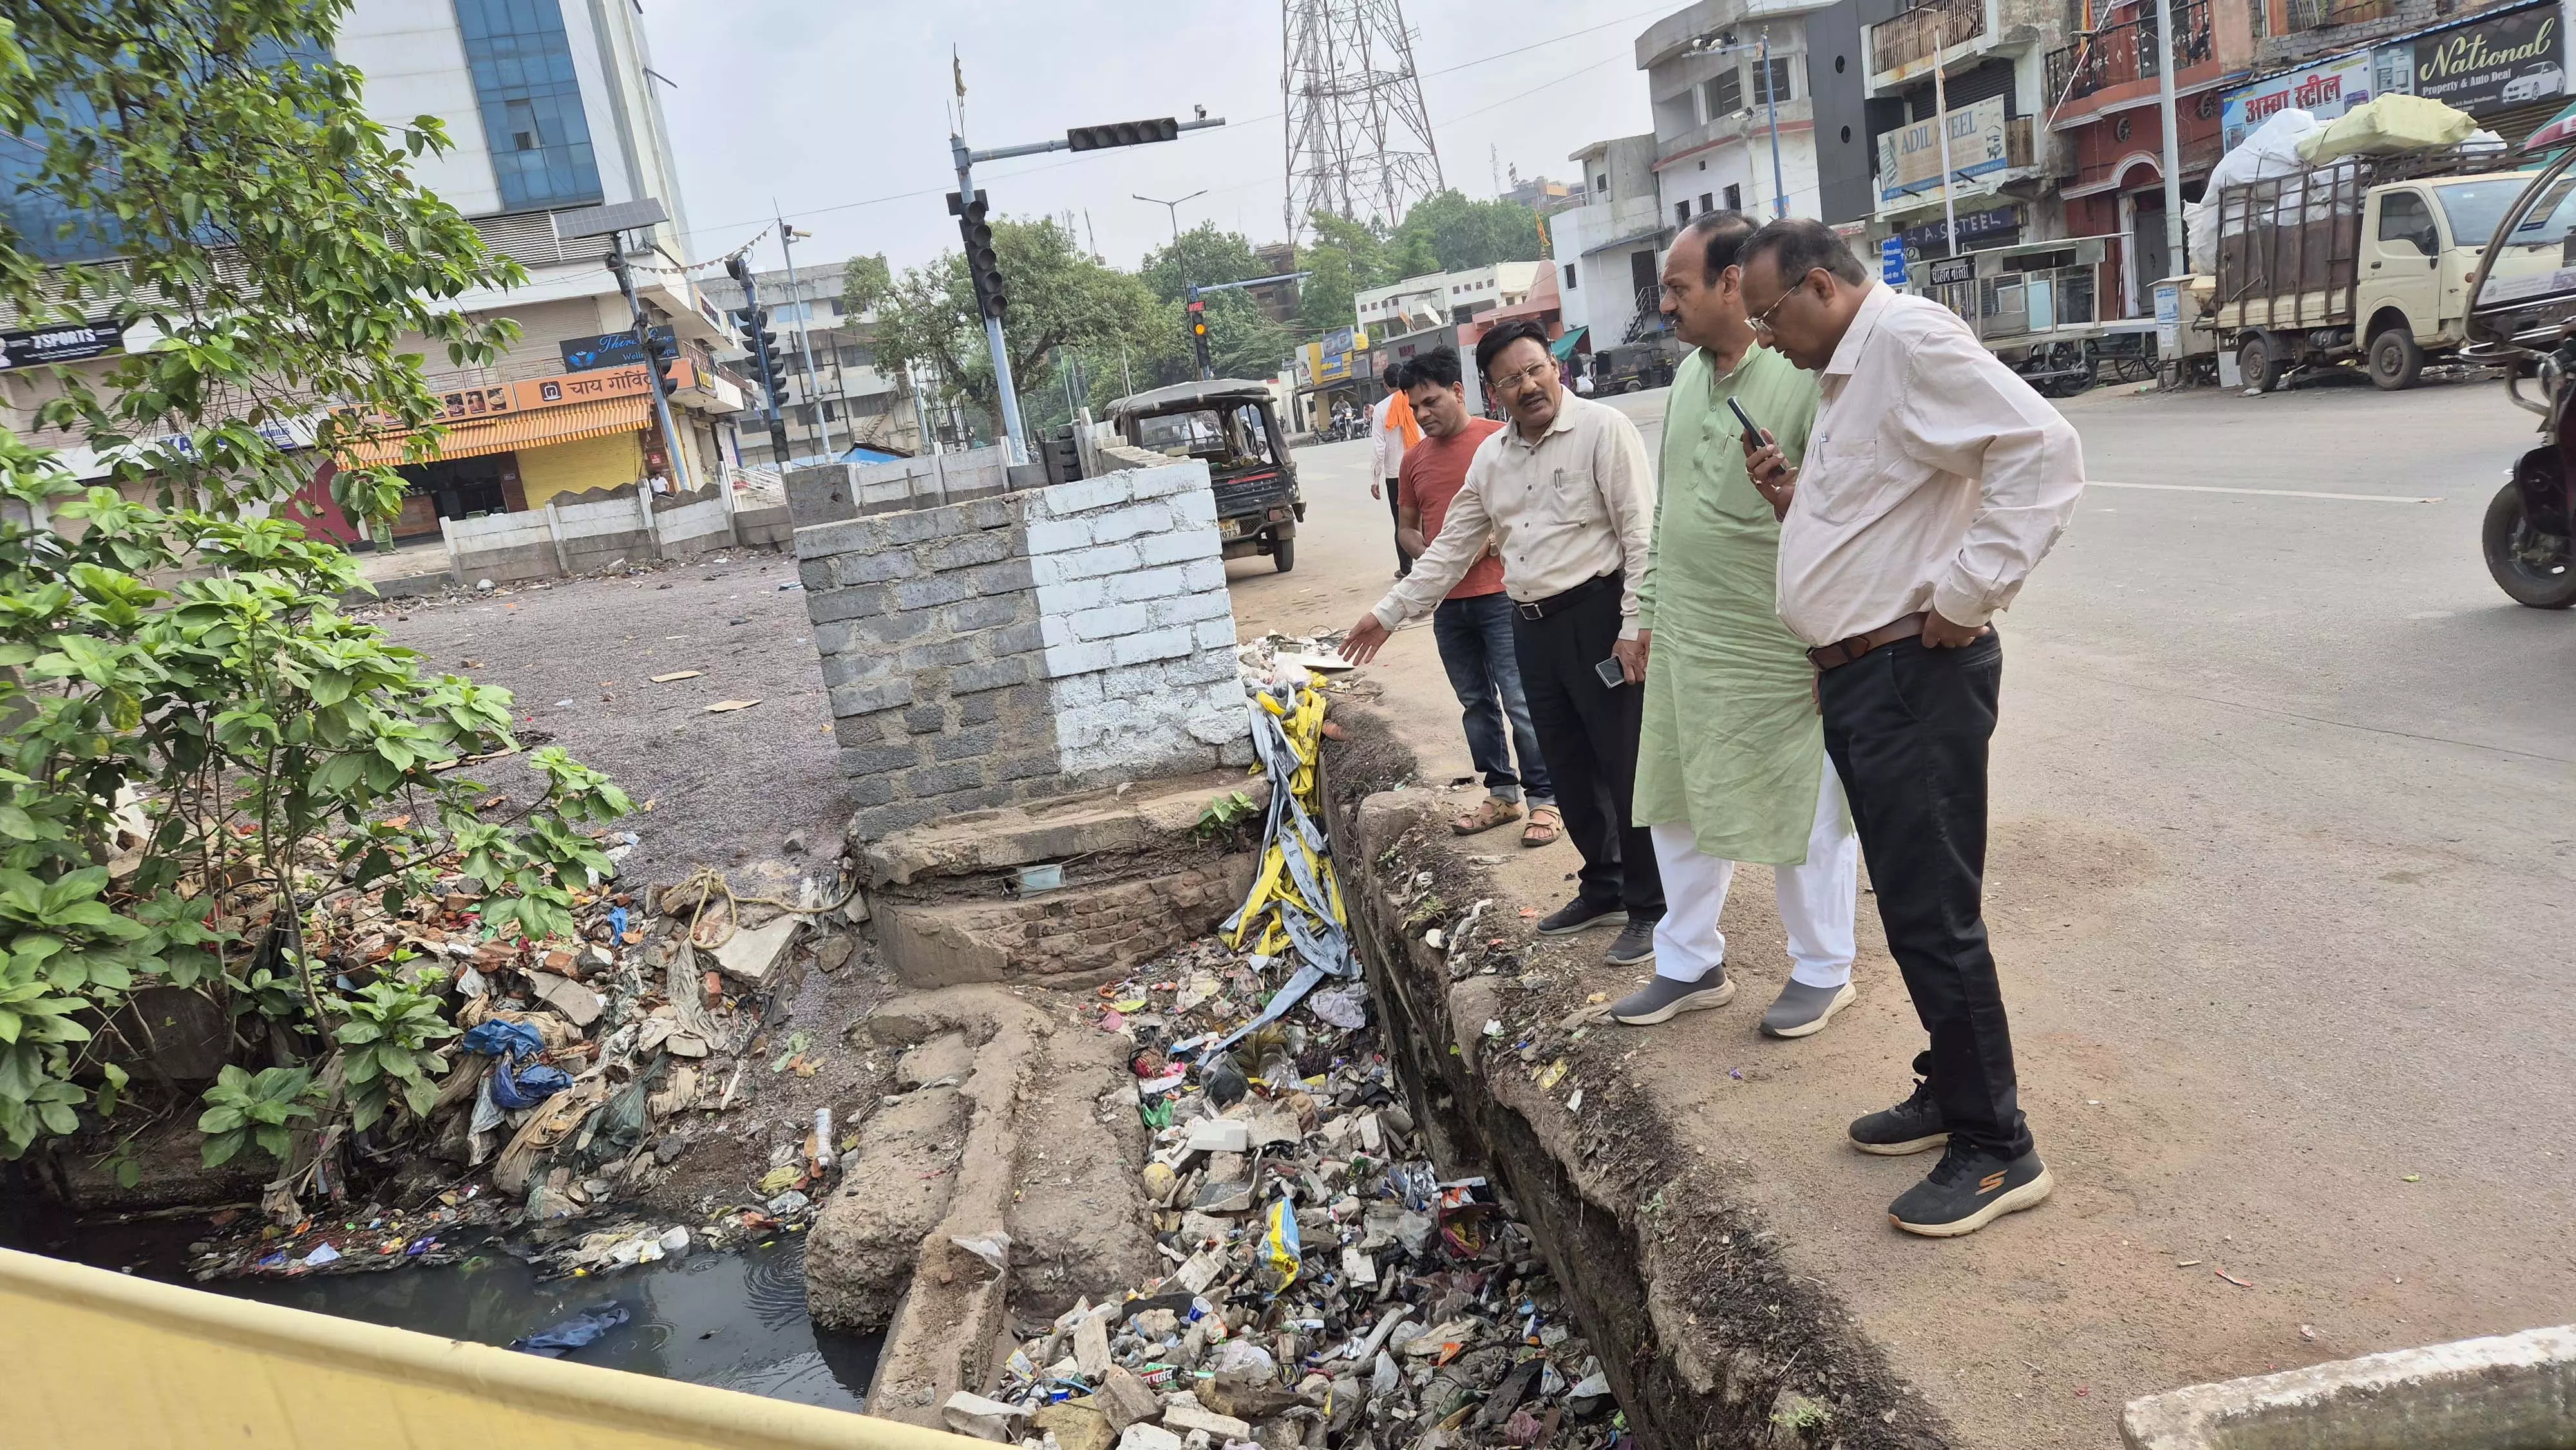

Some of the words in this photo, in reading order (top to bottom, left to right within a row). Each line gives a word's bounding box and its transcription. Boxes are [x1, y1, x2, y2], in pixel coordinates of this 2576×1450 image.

[2420, 17, 2555, 81] National
[2422, 79, 2459, 96] Property
[2461, 79, 2468, 88] &
[2470, 73, 2490, 86] Auto
[1901, 125, 1931, 155] ADIL
[1935, 111, 1977, 144] TEEL
[567, 379, 603, 395] चाय
